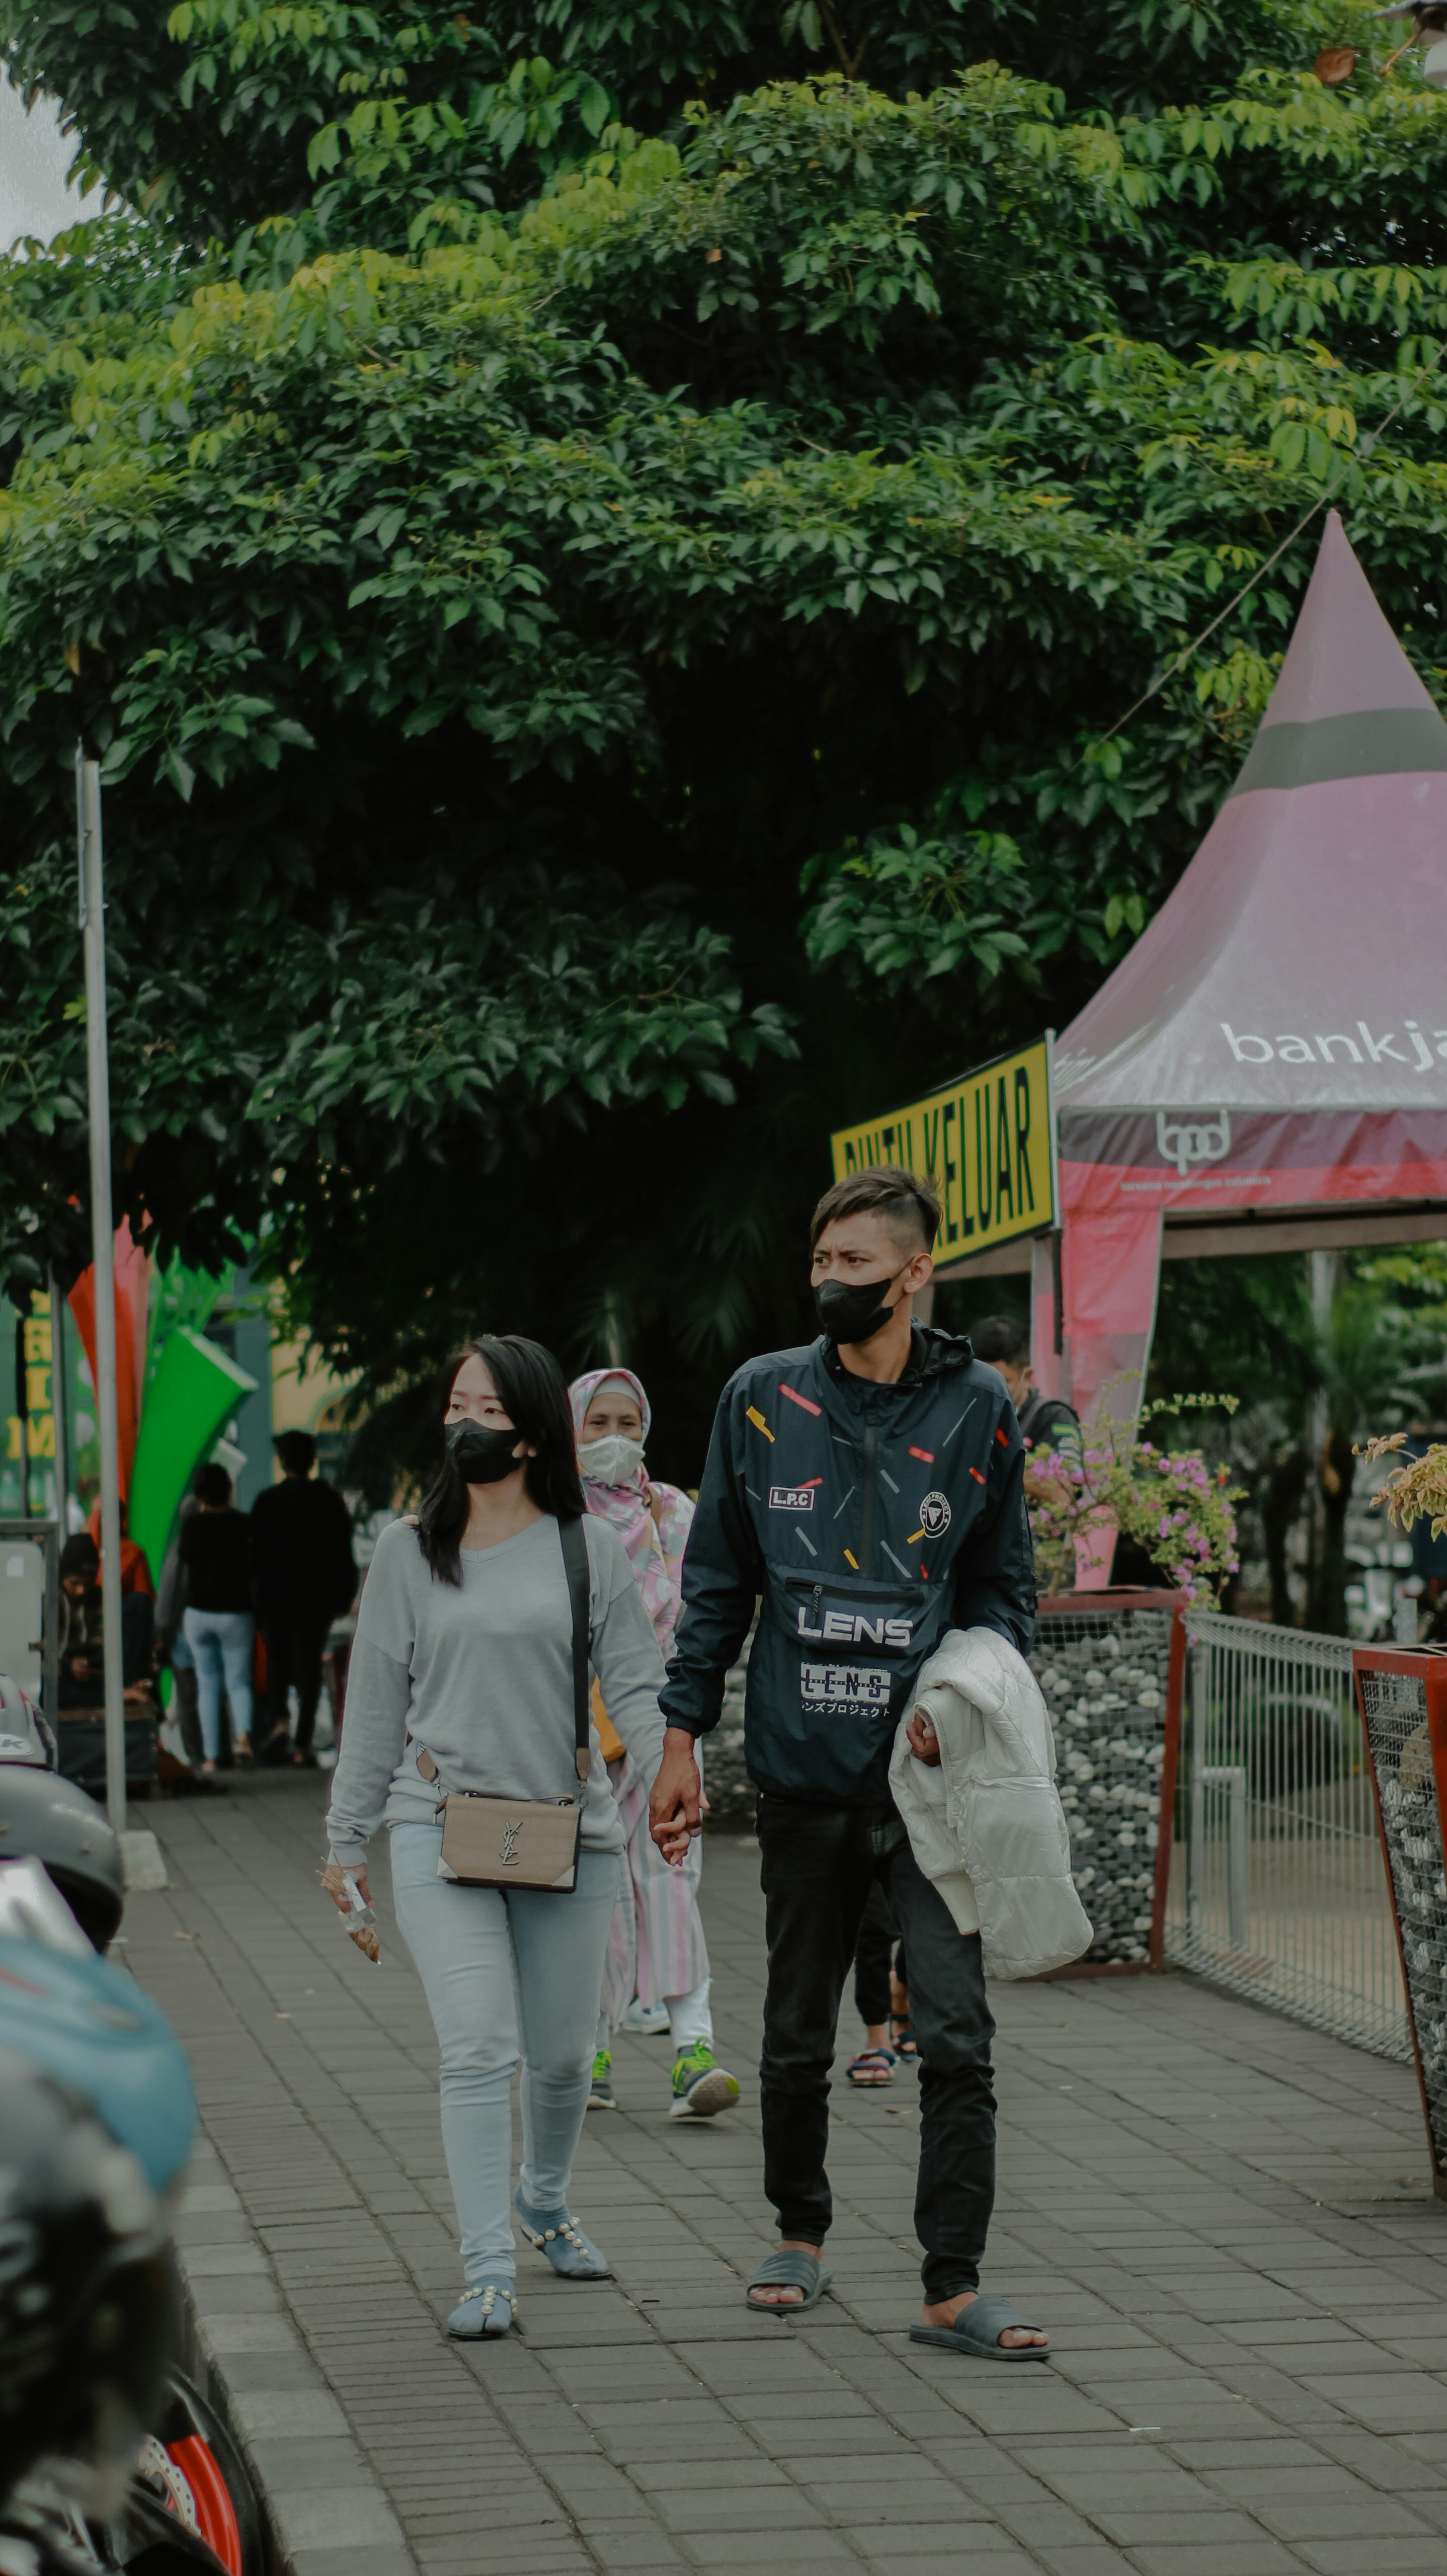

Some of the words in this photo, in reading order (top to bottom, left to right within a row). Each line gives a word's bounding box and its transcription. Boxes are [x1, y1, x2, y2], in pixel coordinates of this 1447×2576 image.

[1121, 1181, 1162, 1191] bersama
[1164, 1179, 1222, 1191] membangun
[773, 1491, 808, 1506] L.P.C
[931, 1494, 950, 1516] PROJECT
[798, 1607, 914, 1647] LENS
[805, 1669, 882, 1698] LENS
[802, 1701, 890, 1718] ンズプロジェクト
